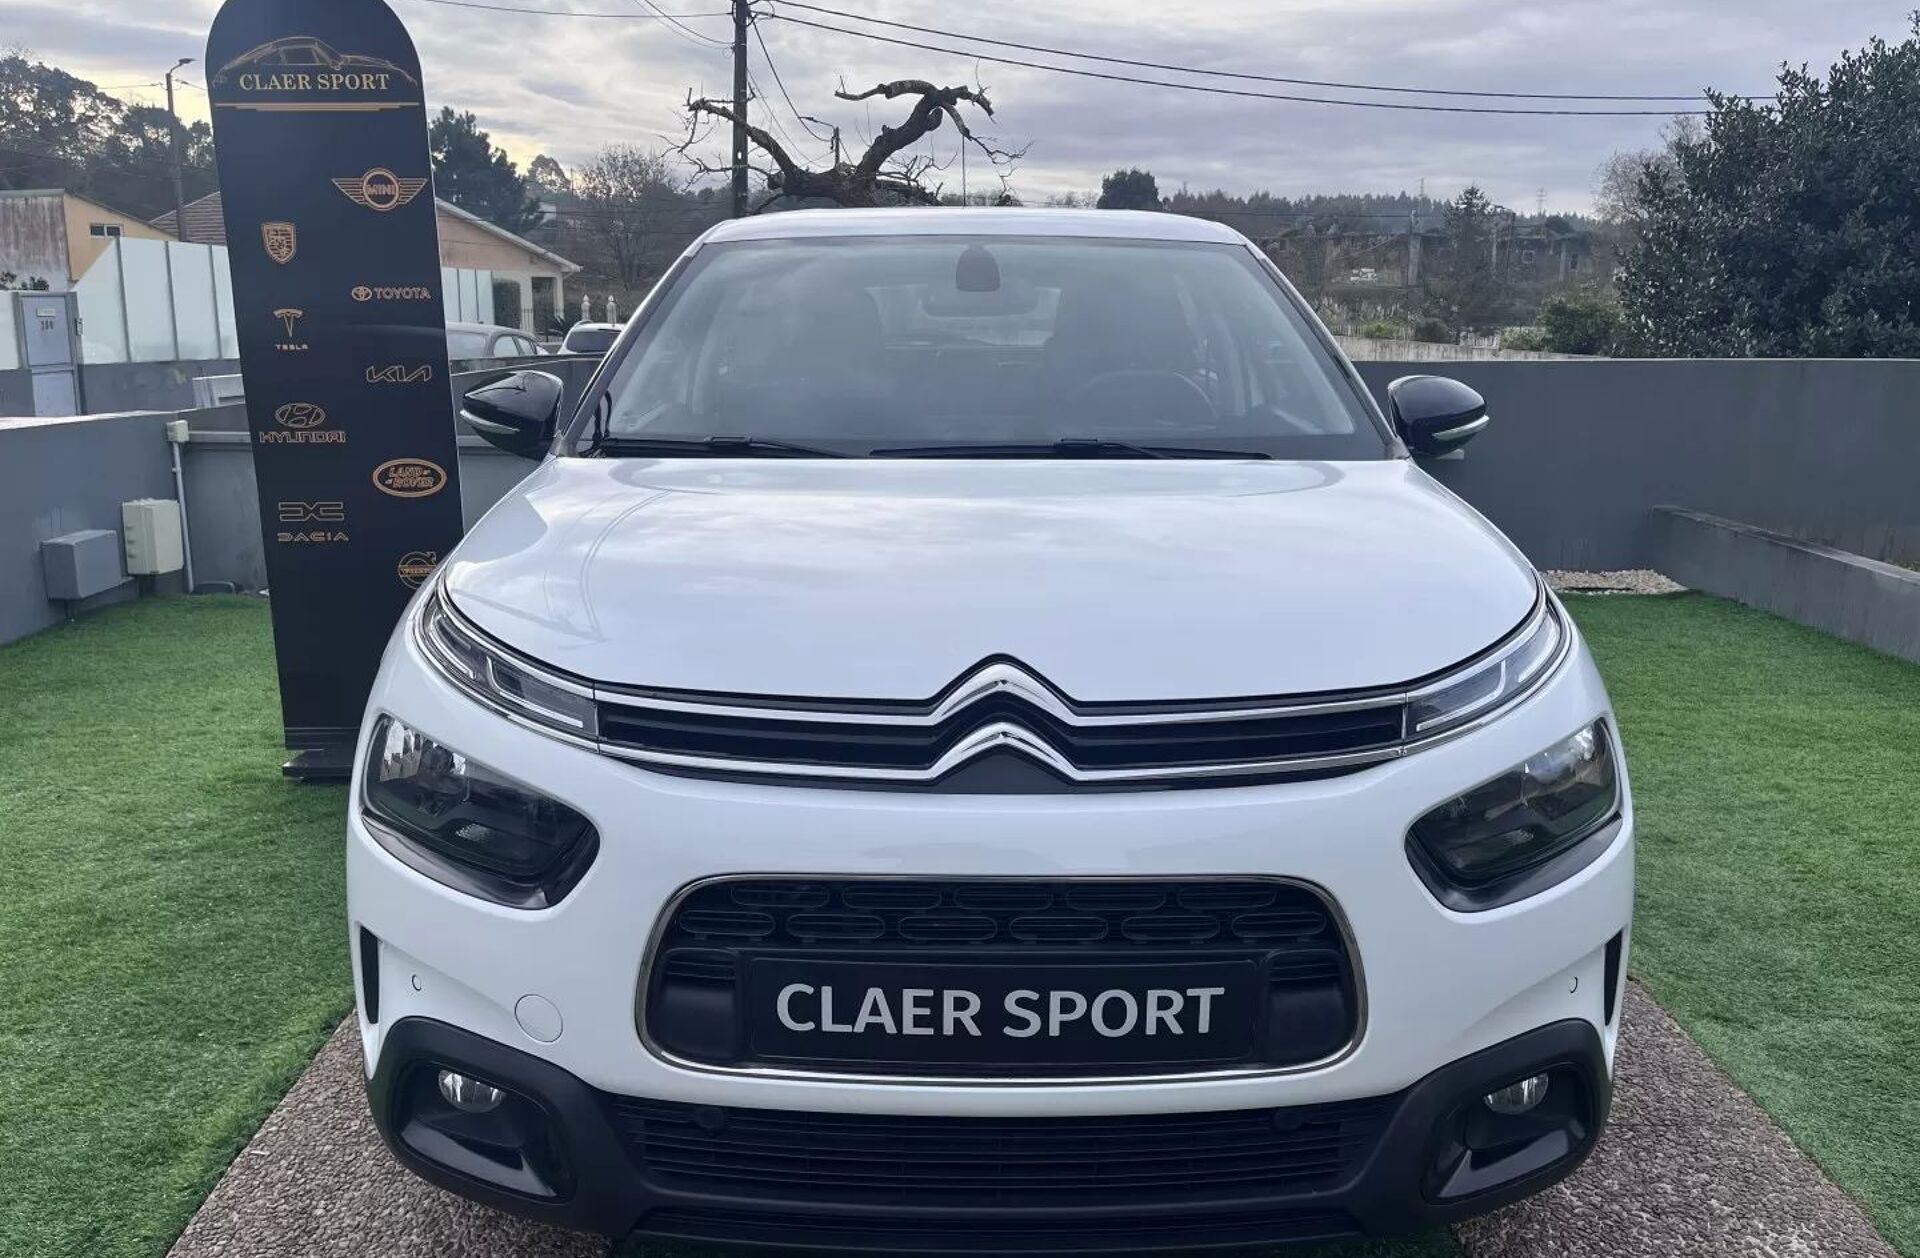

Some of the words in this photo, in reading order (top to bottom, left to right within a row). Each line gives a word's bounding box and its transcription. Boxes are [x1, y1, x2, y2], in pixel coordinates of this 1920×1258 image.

[239, 74, 312, 91] CLAER
[317, 74, 390, 91] SPORT
[365, 184, 397, 196] MINI
[373, 287, 432, 300] TOYOTA
[366, 364, 432, 383] KIA
[259, 430, 347, 443] HYUNDAI
[277, 531, 349, 542] DACIA
[776, 983, 983, 1037] CLAER
[1003, 987, 1226, 1038] SPORT
